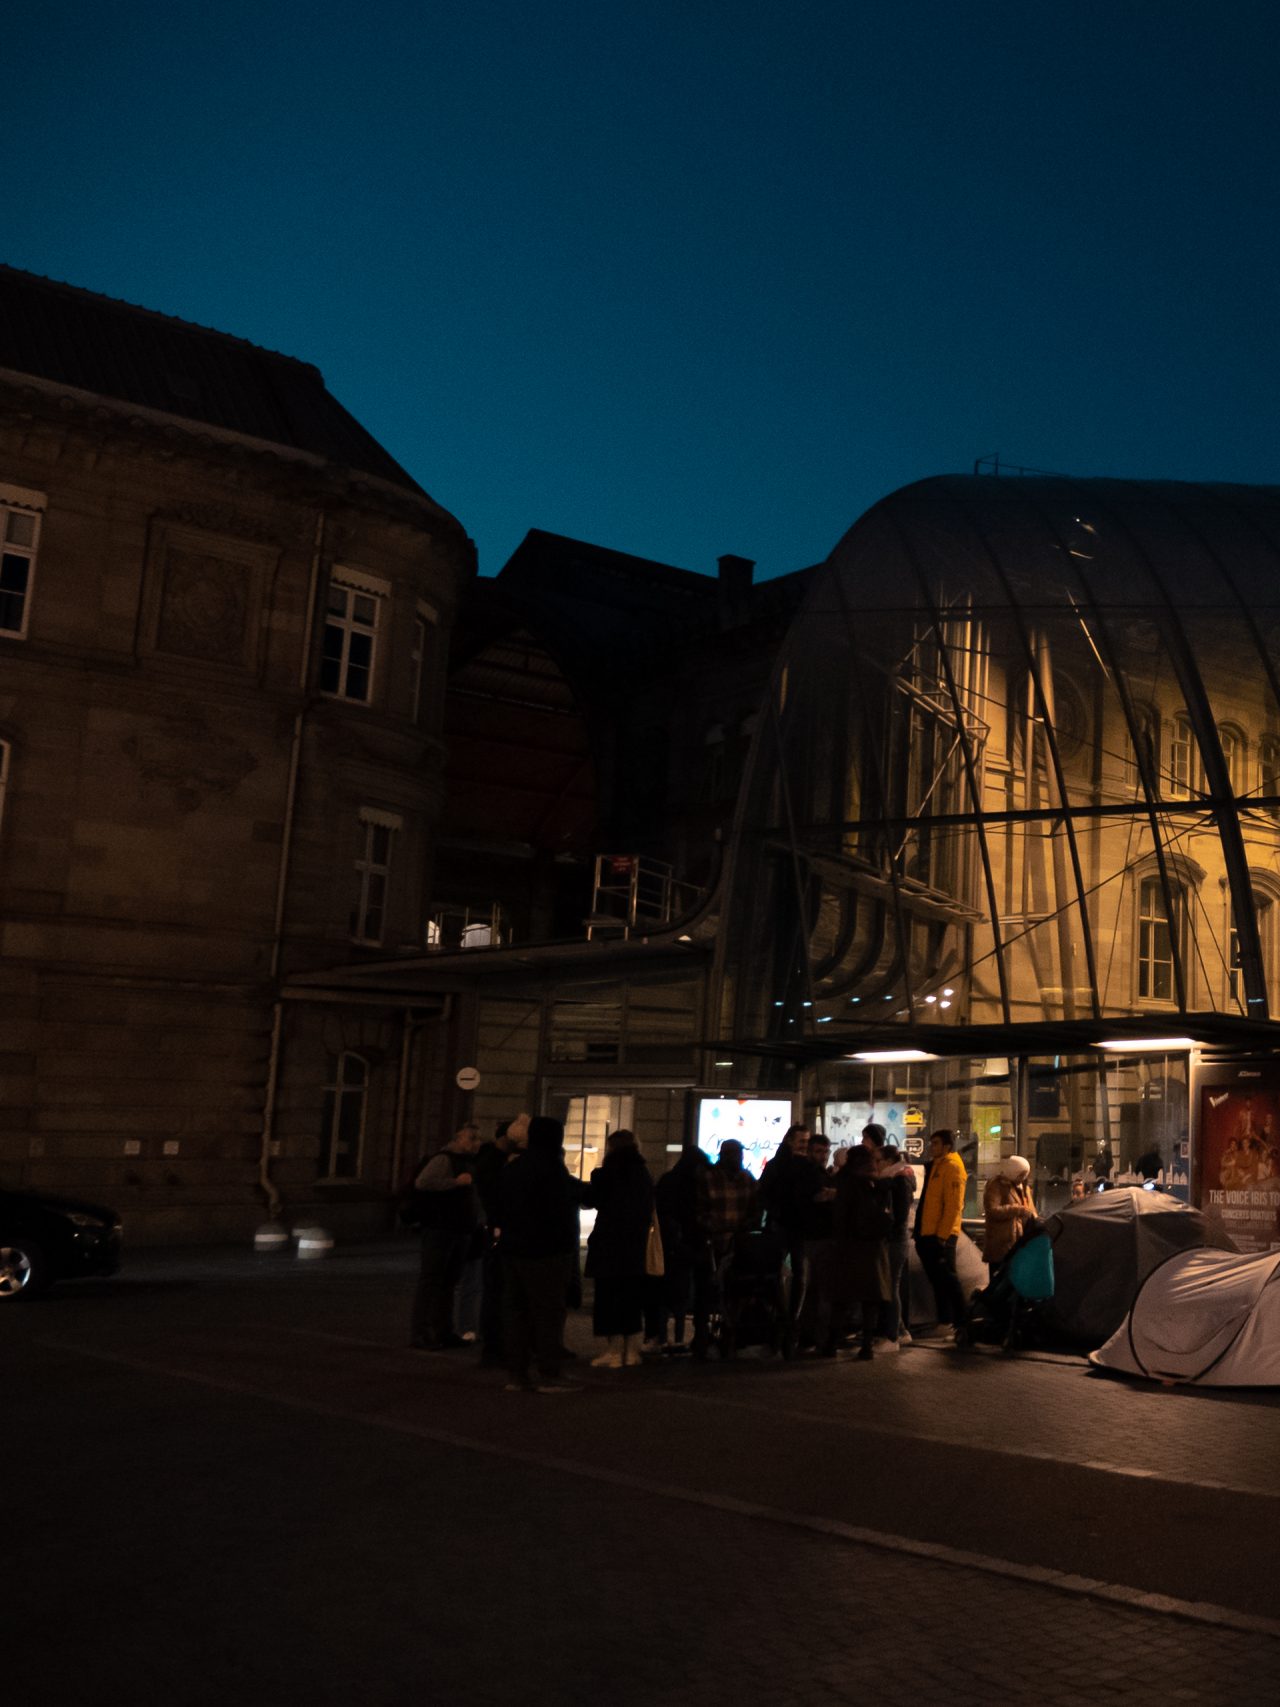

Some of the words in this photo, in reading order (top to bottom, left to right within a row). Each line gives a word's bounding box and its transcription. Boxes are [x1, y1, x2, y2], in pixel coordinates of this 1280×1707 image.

[1209, 1189, 1224, 1204] THE
[1225, 1190, 1249, 1205] VOICE
[1251, 1191, 1268, 1206] IBIS
